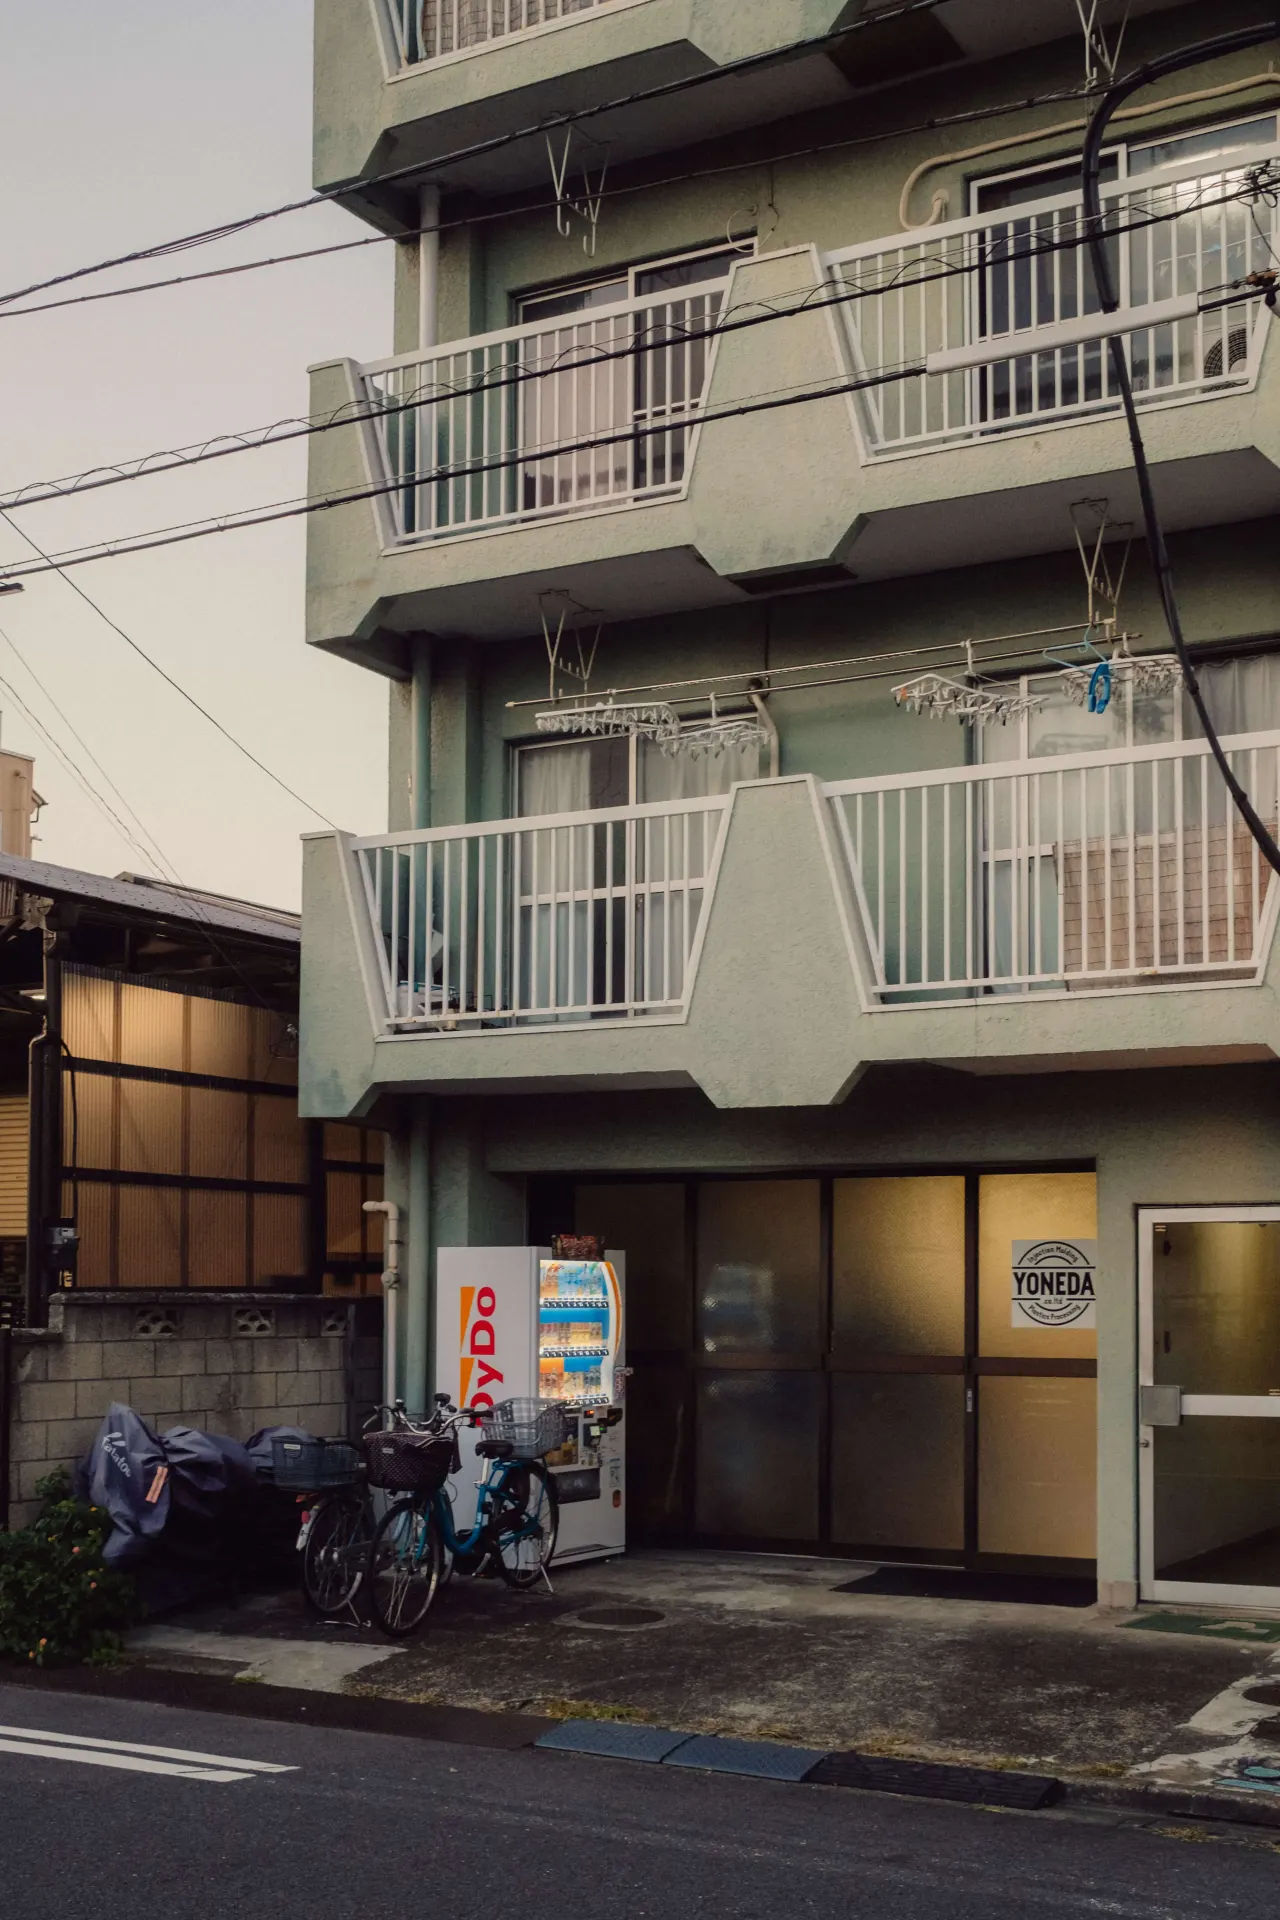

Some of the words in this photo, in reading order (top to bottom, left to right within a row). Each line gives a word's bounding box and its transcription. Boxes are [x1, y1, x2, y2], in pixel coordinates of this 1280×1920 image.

[1027, 1246, 1055, 1263] Injection
[1056, 1246, 1079, 1263] Molding
[1013, 1272, 1095, 1295] YONEDA
[1028, 1304, 1050, 1320] Plastics
[1050, 1304, 1081, 1320] Processing
